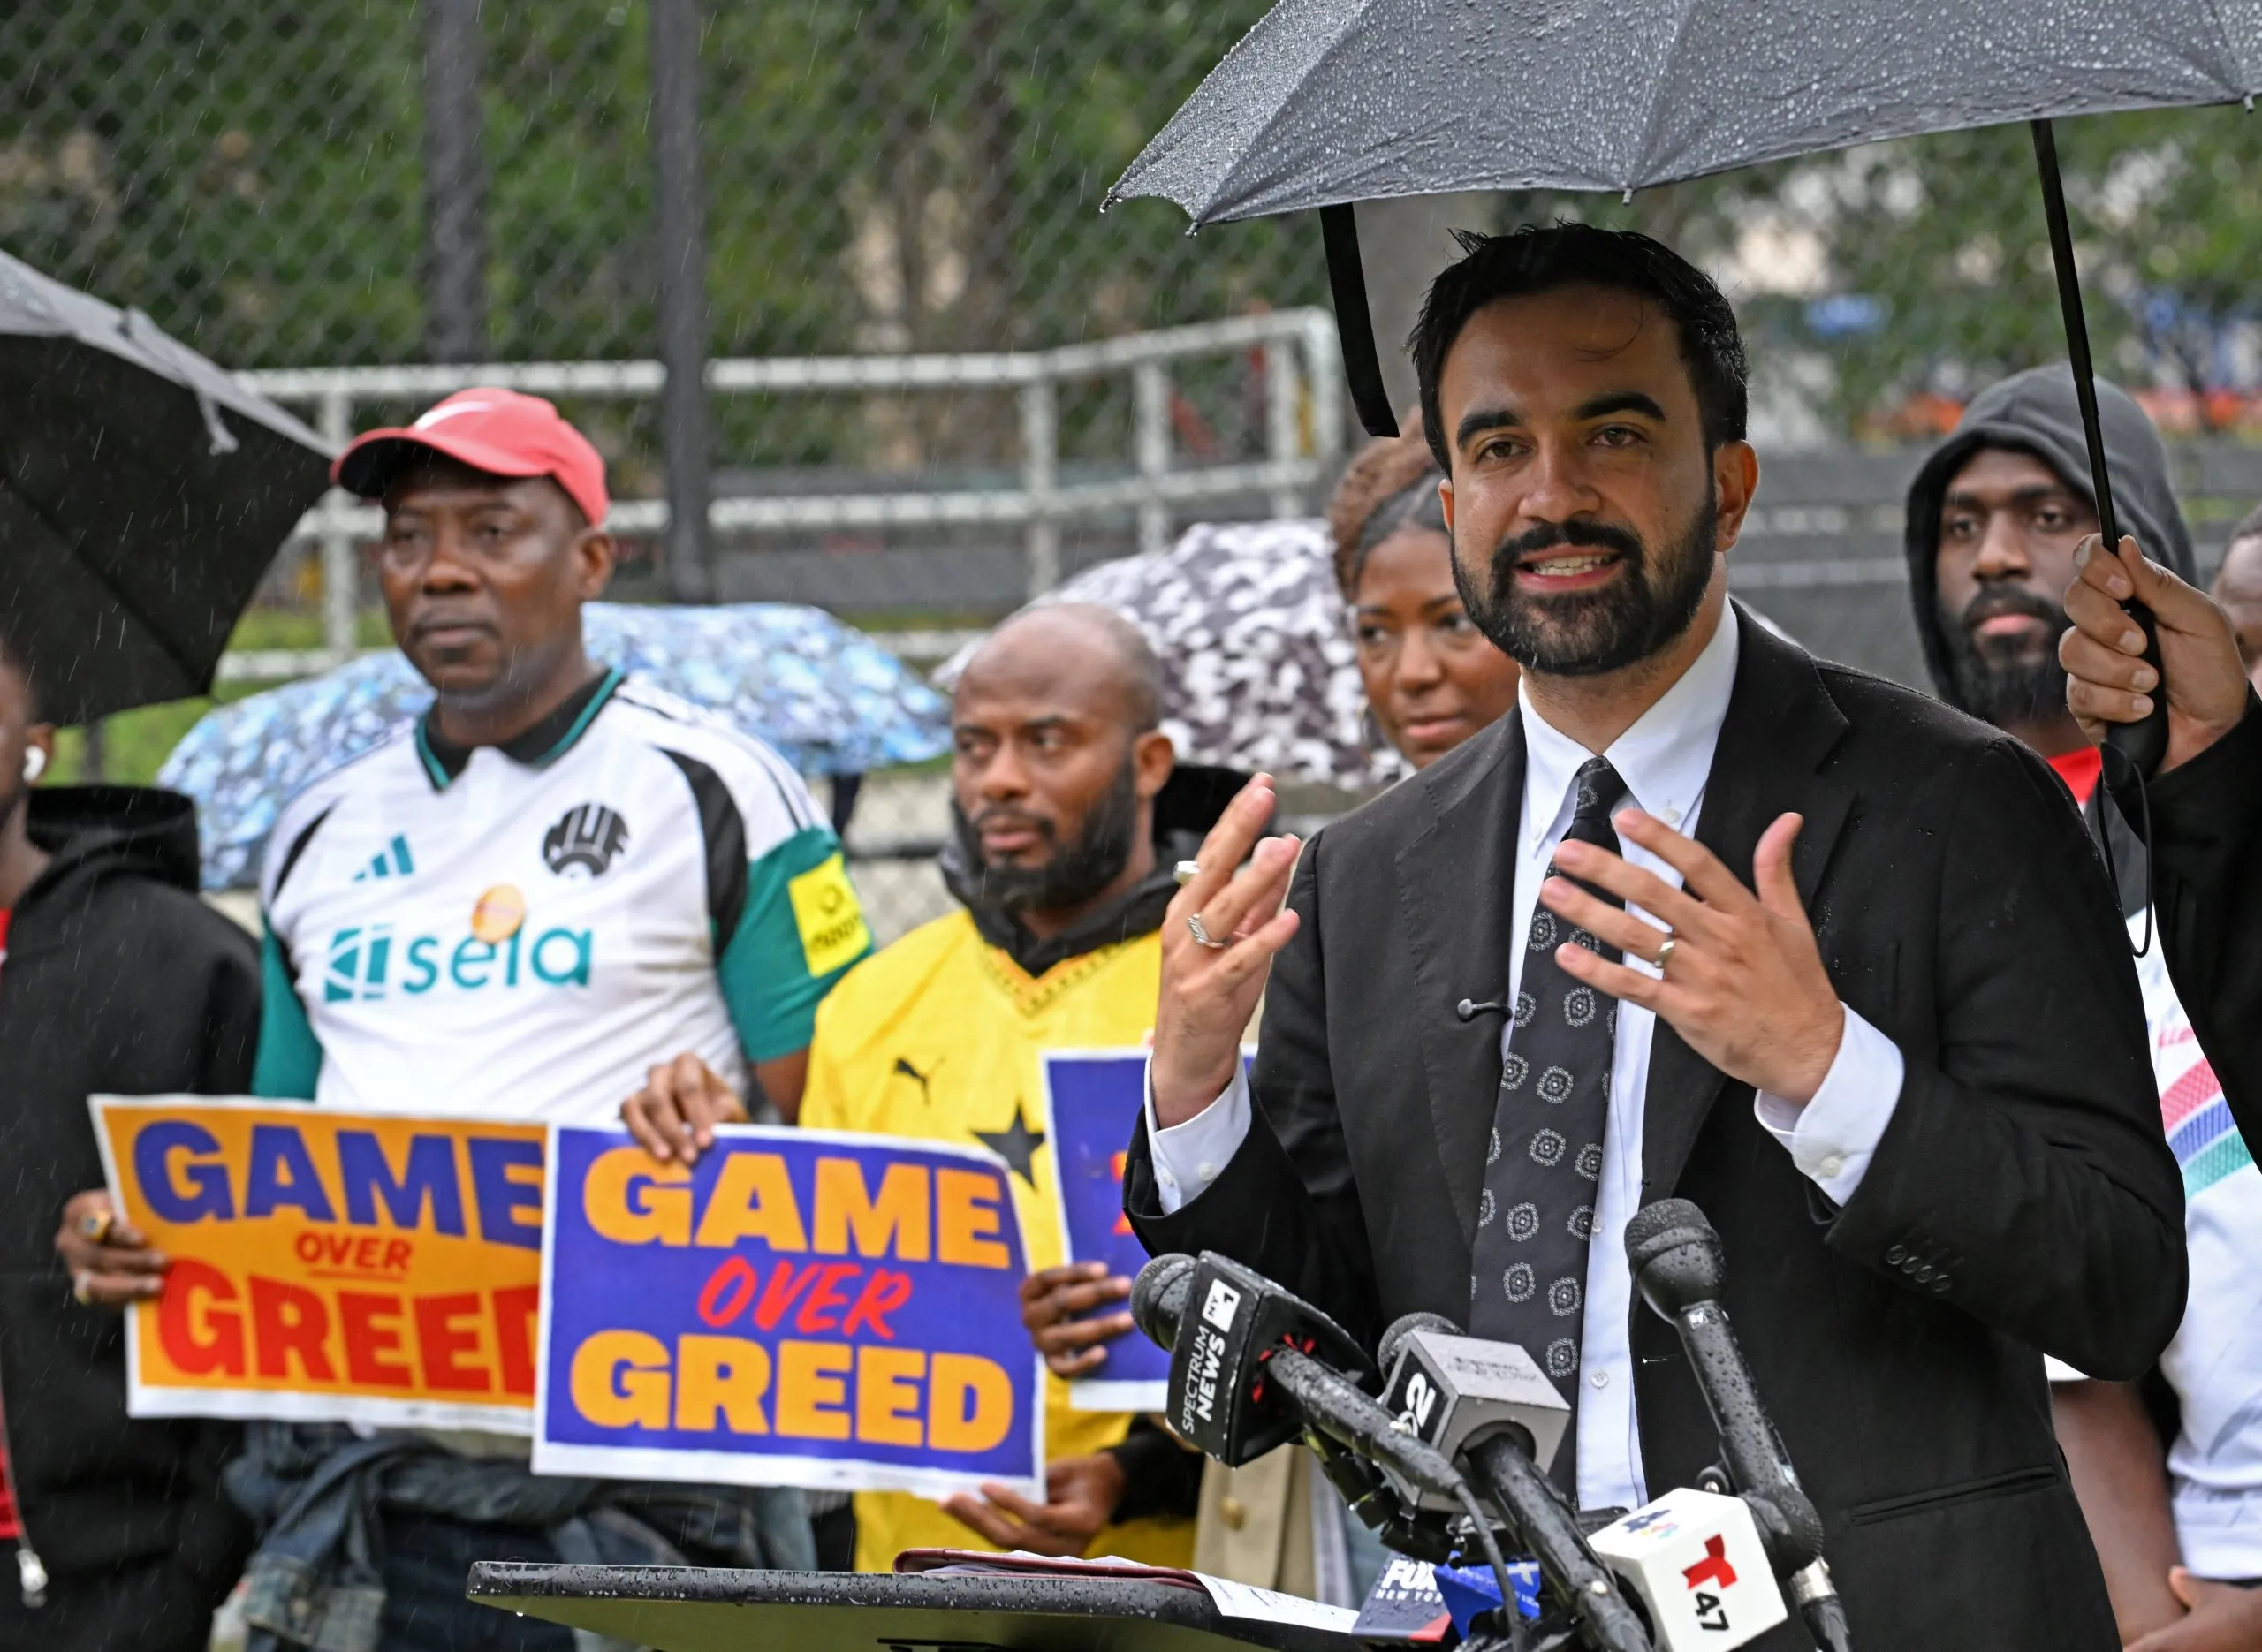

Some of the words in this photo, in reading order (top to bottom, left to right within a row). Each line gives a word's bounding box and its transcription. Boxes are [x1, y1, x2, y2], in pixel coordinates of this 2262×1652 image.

[403, 922, 592, 993] sela
[133, 1120, 543, 1252] GAME
[583, 1147, 1011, 1269] GAME
[294, 1231, 414, 1270] OVER
[696, 1255, 913, 1339] OVER
[569, 1329, 1014, 1453] GREED
[1182, 1324, 1210, 1435] SPECTRUM
[1196, 1333, 1226, 1422] NEWS
[1406, 1373, 1437, 1428] 2
[1375, 1588, 1409, 1602] NEW
[1414, 1590, 1444, 1604] YOR
[1380, 1559, 1438, 1591] FOX
[1696, 1592, 1729, 1631] 47
